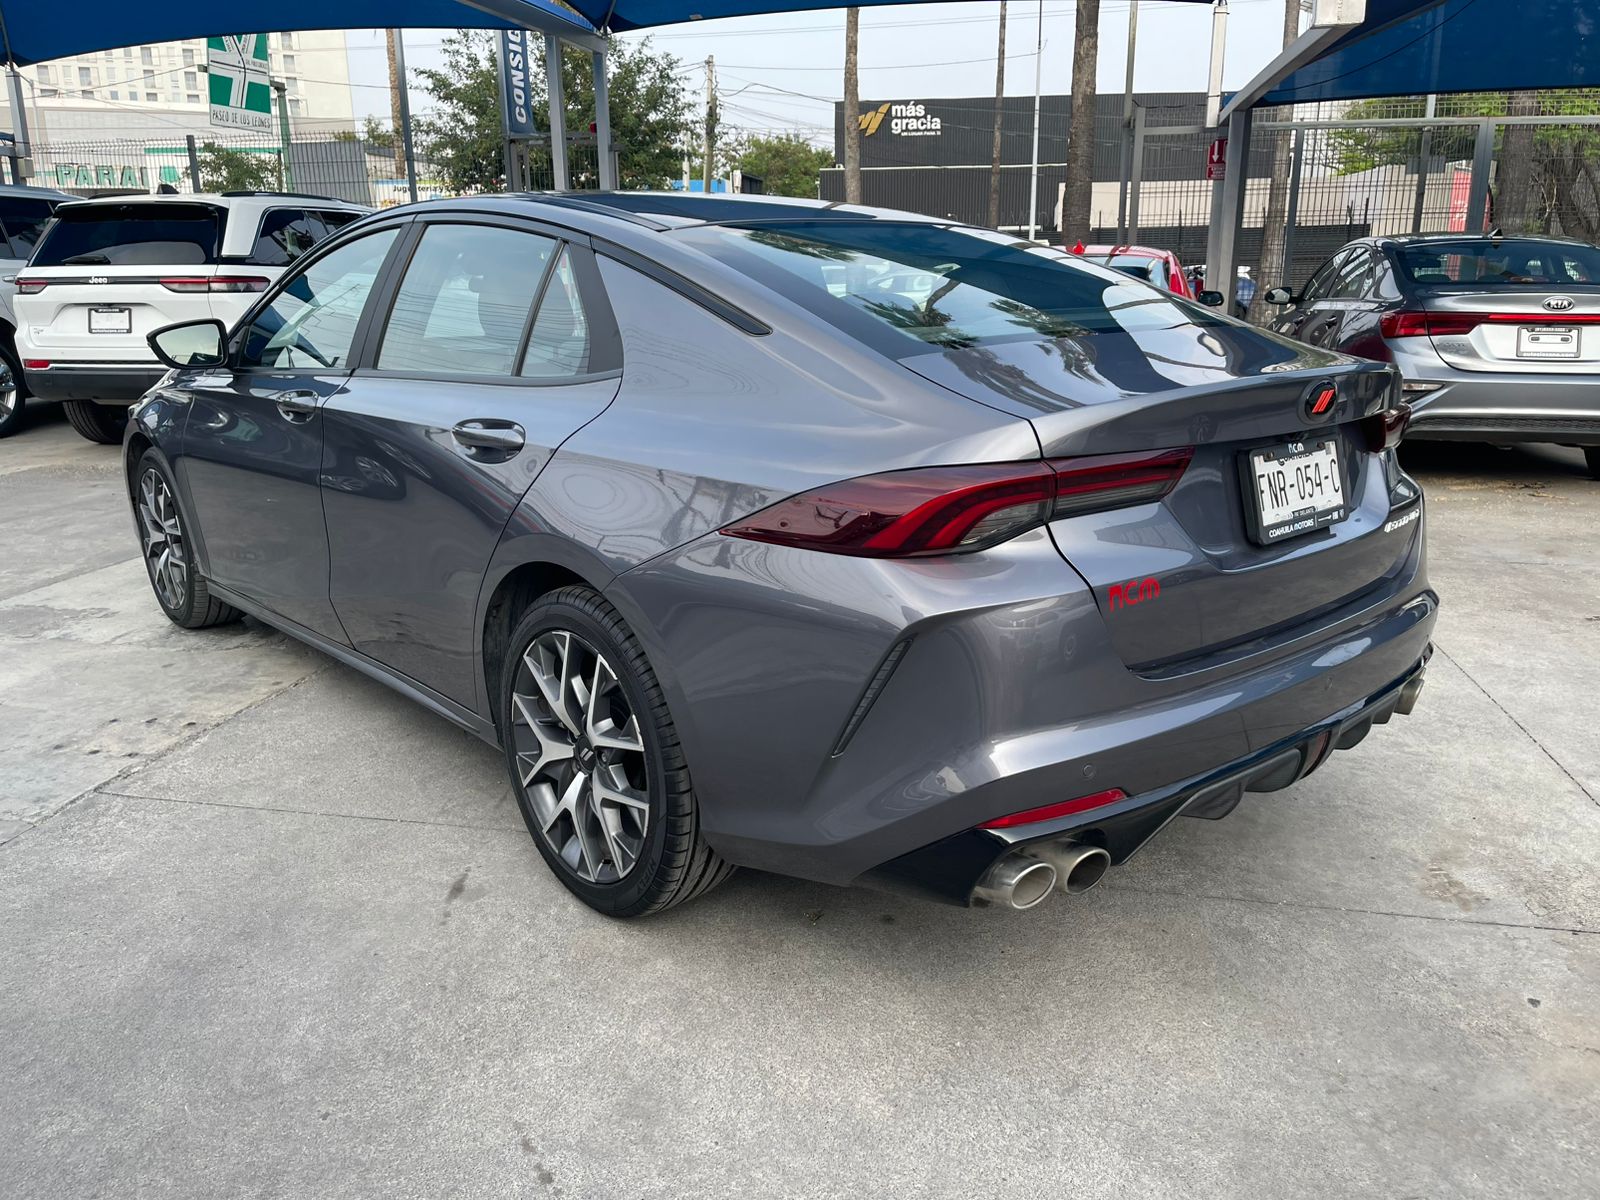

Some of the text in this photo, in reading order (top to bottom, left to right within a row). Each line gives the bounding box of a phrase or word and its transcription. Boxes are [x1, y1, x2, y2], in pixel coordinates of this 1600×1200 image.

[891, 101, 925, 117] más
[212, 110, 270, 128] PASEO DE LOS LEONES
[891, 114, 941, 134] gracia
[89, 276, 108, 284] Jeep
[1550, 300, 1569, 308] KIA
[1257, 458, 1340, 512] FNR-054-C
[1269, 524, 1294, 538] COAHUILA
